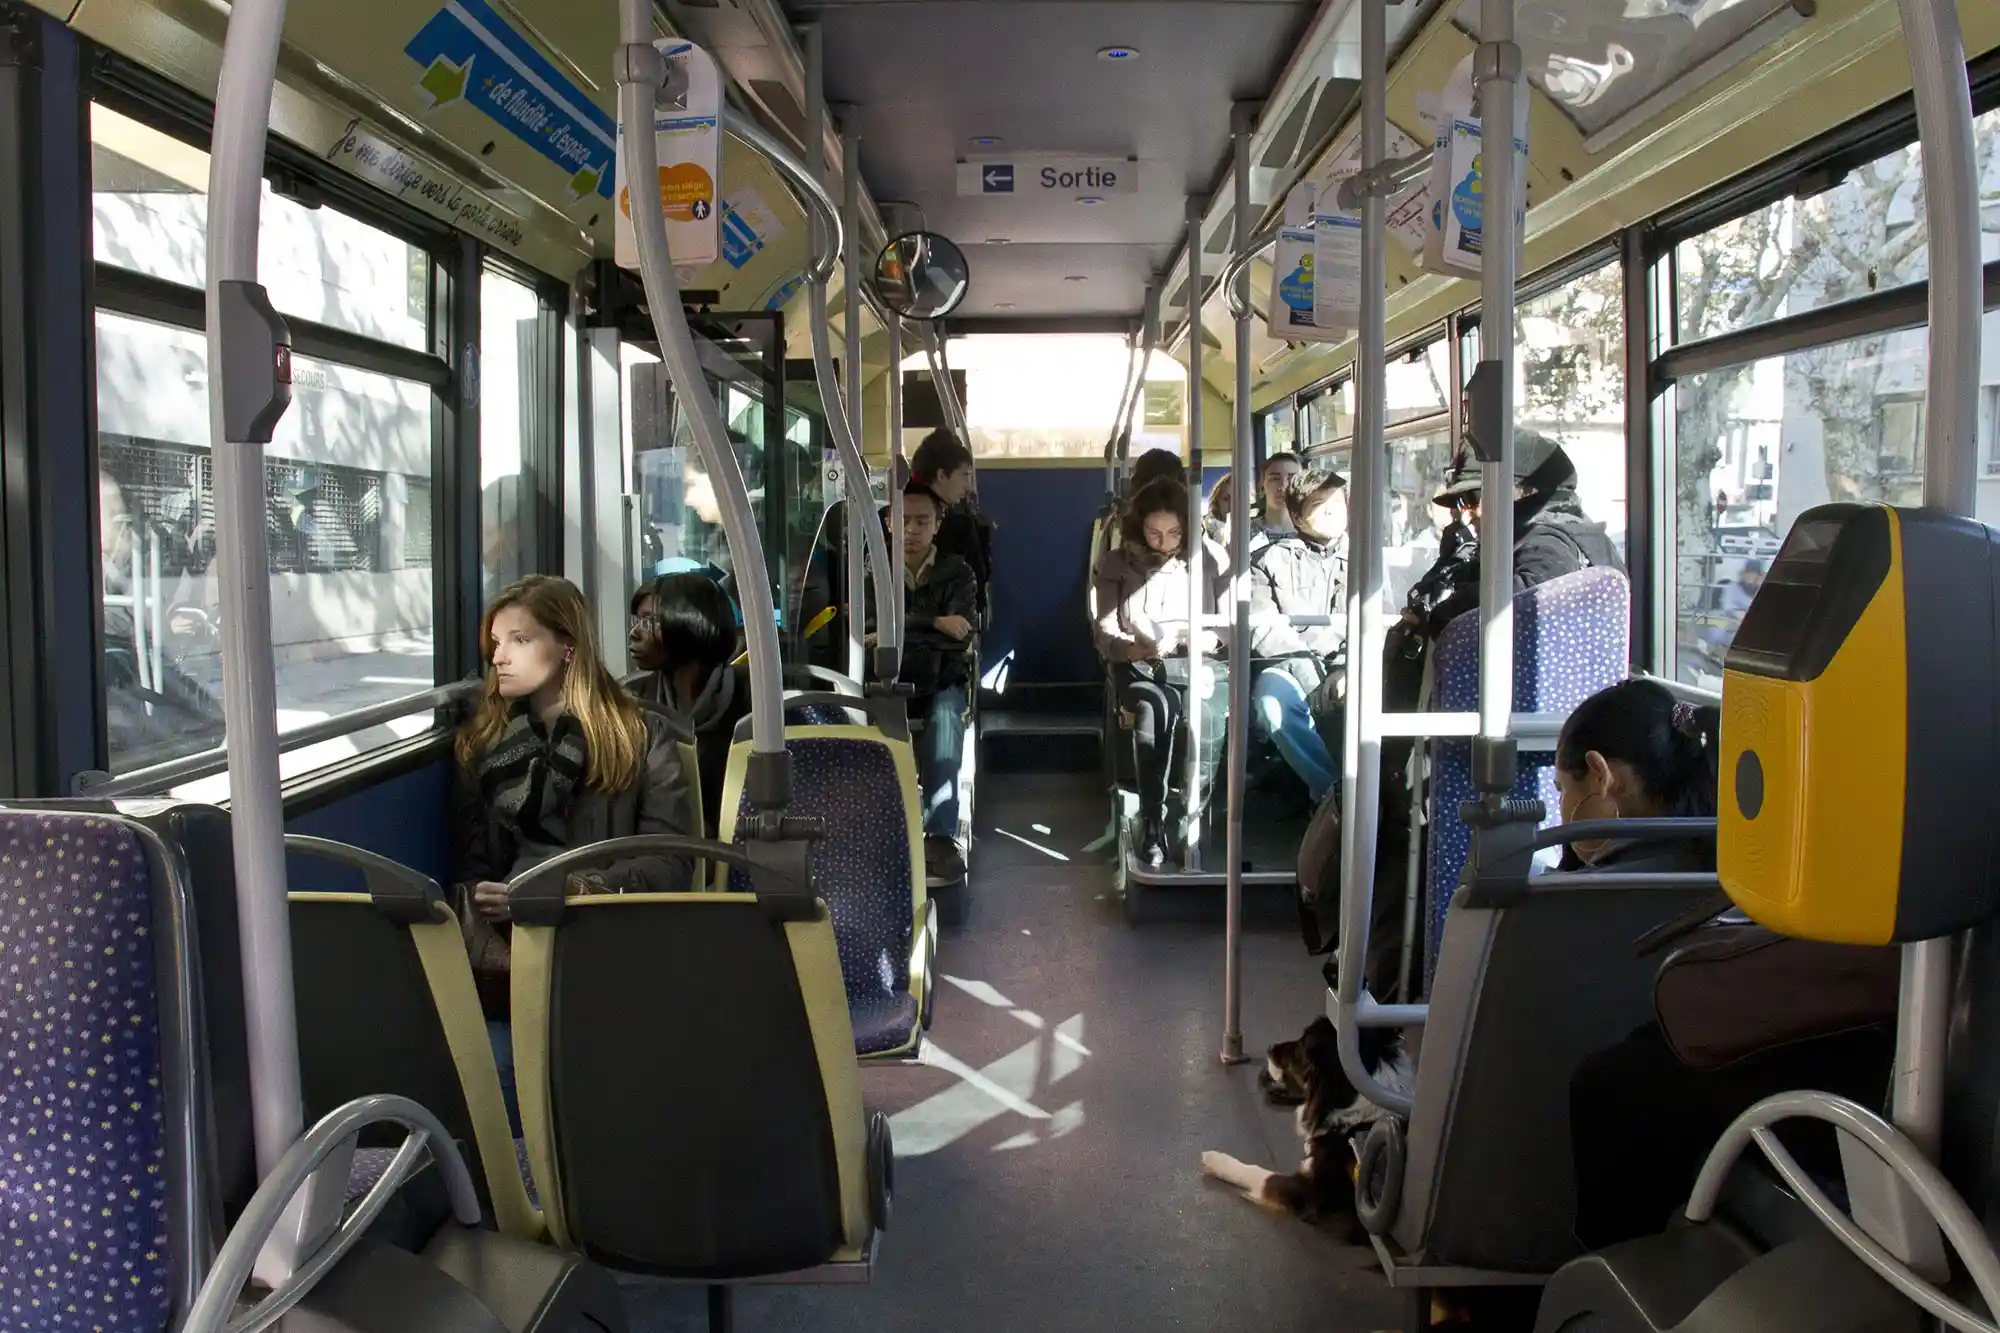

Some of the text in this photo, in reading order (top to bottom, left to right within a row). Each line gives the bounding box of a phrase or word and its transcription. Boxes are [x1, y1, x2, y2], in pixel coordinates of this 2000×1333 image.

[488, 78, 513, 105] de
[326, 117, 361, 160] Je
[420, 179, 452, 205] vers
[1040, 166, 1117, 189] Sortie
[292, 369, 326, 390] SECOURS
